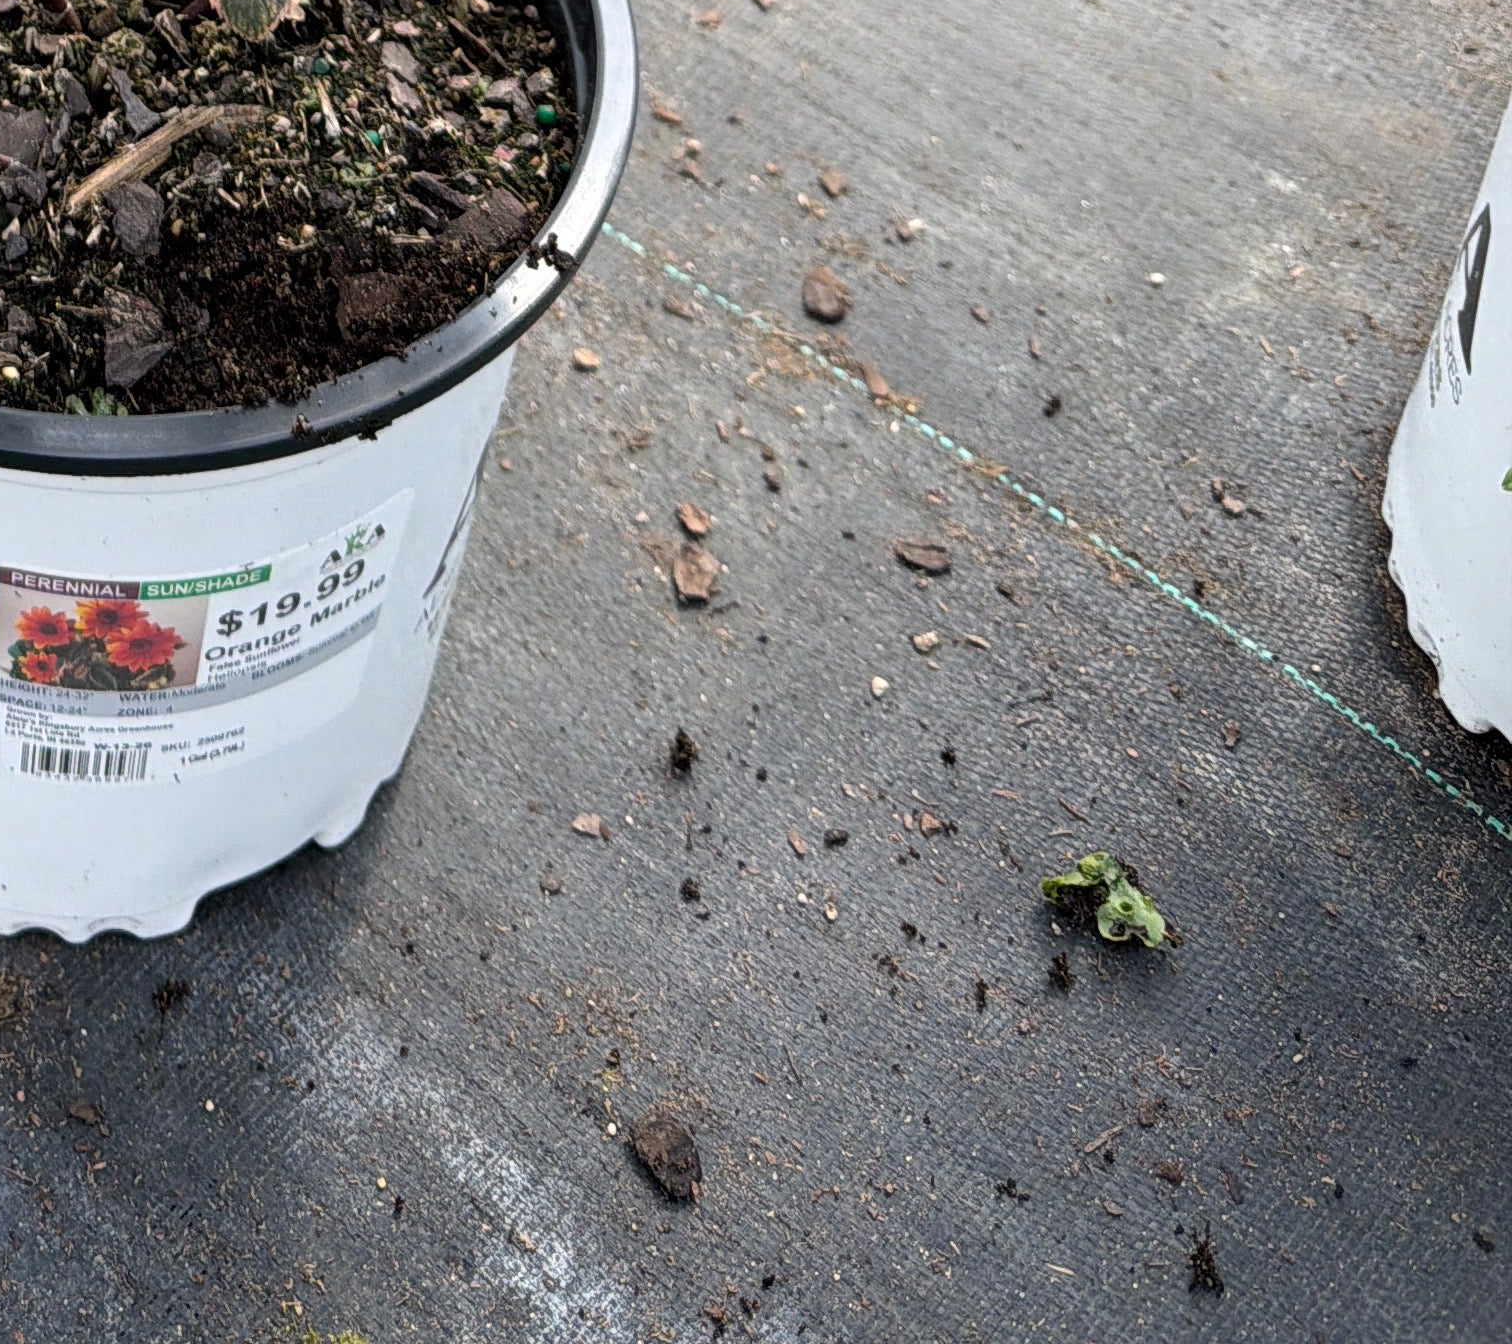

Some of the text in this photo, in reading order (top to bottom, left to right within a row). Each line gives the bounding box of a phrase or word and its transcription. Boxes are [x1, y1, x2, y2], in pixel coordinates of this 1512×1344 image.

[320, 523, 386, 573] AKA
[11, 570, 127, 599] PERENNIAL
[147, 569, 262, 597] SUN/SHADE
[216, 558, 366, 638] $19.99
[204, 623, 302, 662] Orange
[310, 574, 386, 627] Marble
[208, 637, 302, 673] False Sunflower
[0, 678, 52, 696] HEIGHT:
[0, 693, 47, 711] SPACE:
[118, 723, 174, 733] Greenhouse
